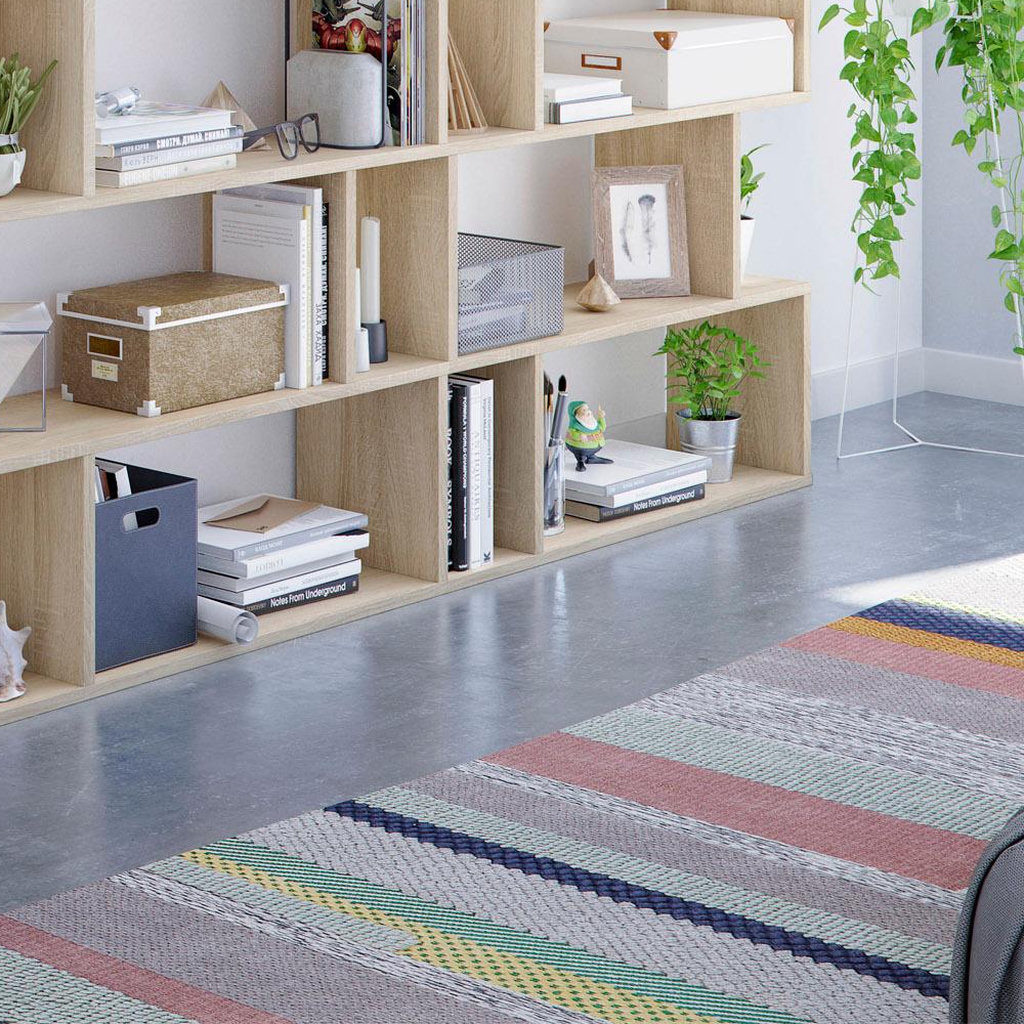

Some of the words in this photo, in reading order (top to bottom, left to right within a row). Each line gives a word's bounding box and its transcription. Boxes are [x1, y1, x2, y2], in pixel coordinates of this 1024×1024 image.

[634, 502, 648, 510] Notes
[648, 498, 661, 508] From
[662, 490, 695, 504] Underground
[270, 597, 288, 607] Notes
[289, 594, 304, 605] From
[306, 582, 346, 599] Underground
